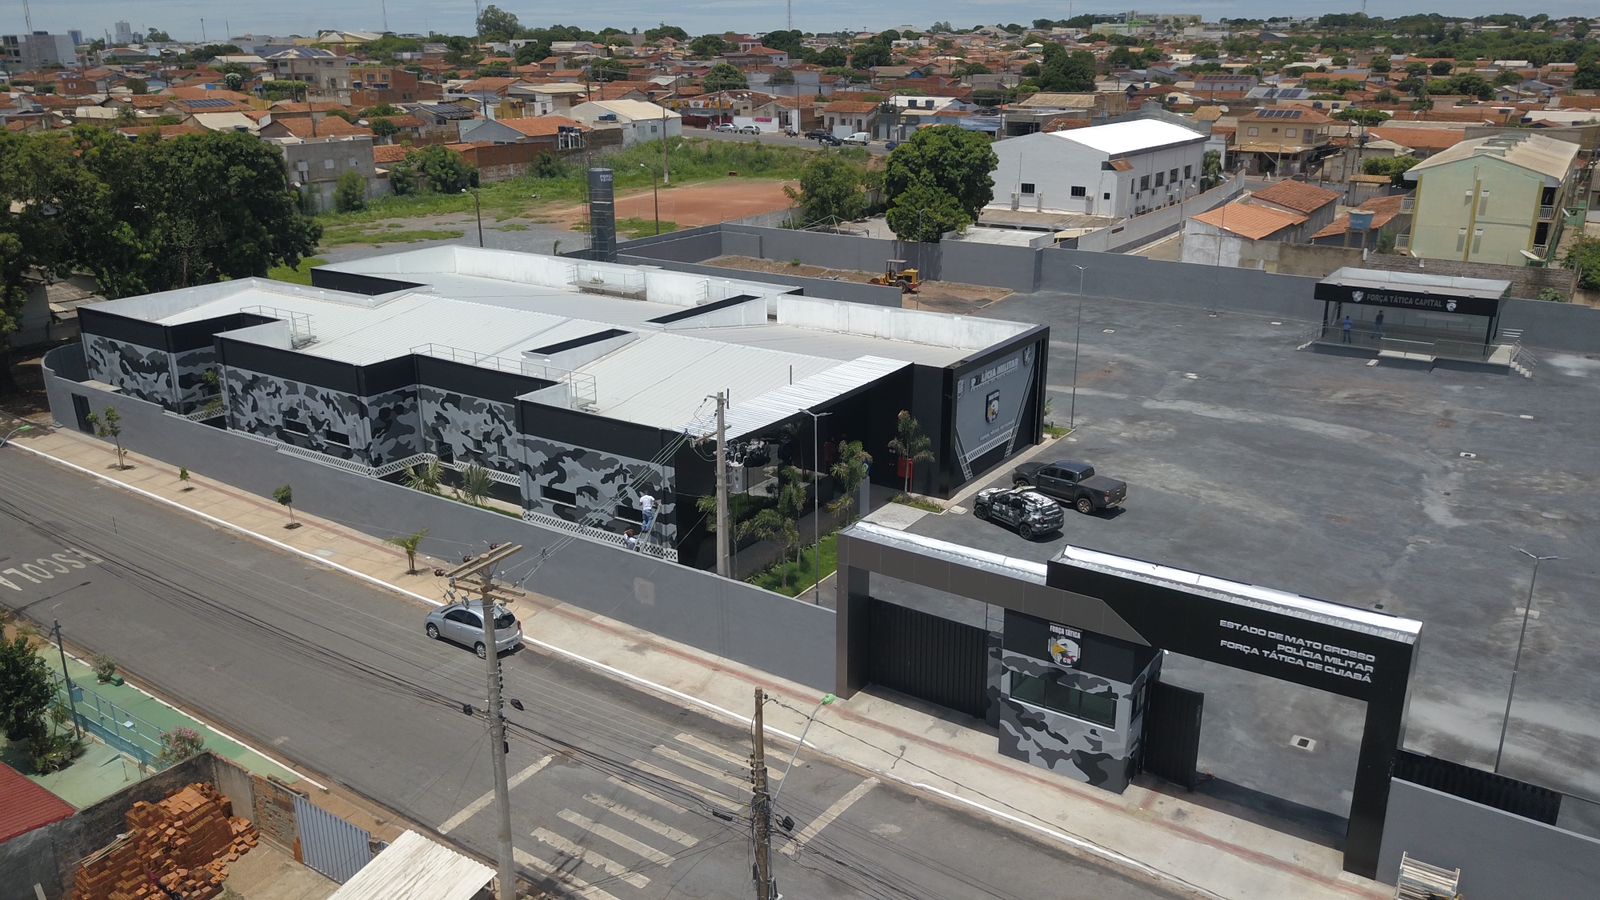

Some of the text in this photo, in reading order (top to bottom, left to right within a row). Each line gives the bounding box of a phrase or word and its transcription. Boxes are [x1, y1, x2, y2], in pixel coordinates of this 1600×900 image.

[1389, 294, 1413, 305] TÁTICA
[1414, 297, 1443, 308] CAPITAL
[1219, 619, 1375, 662] ESTADO DE MATO GROSSO
[1277, 643, 1374, 673] POLÍCIA MILITAR
[1220, 639, 1372, 683] FORÇA TÁTICA DE CUIABÁ
